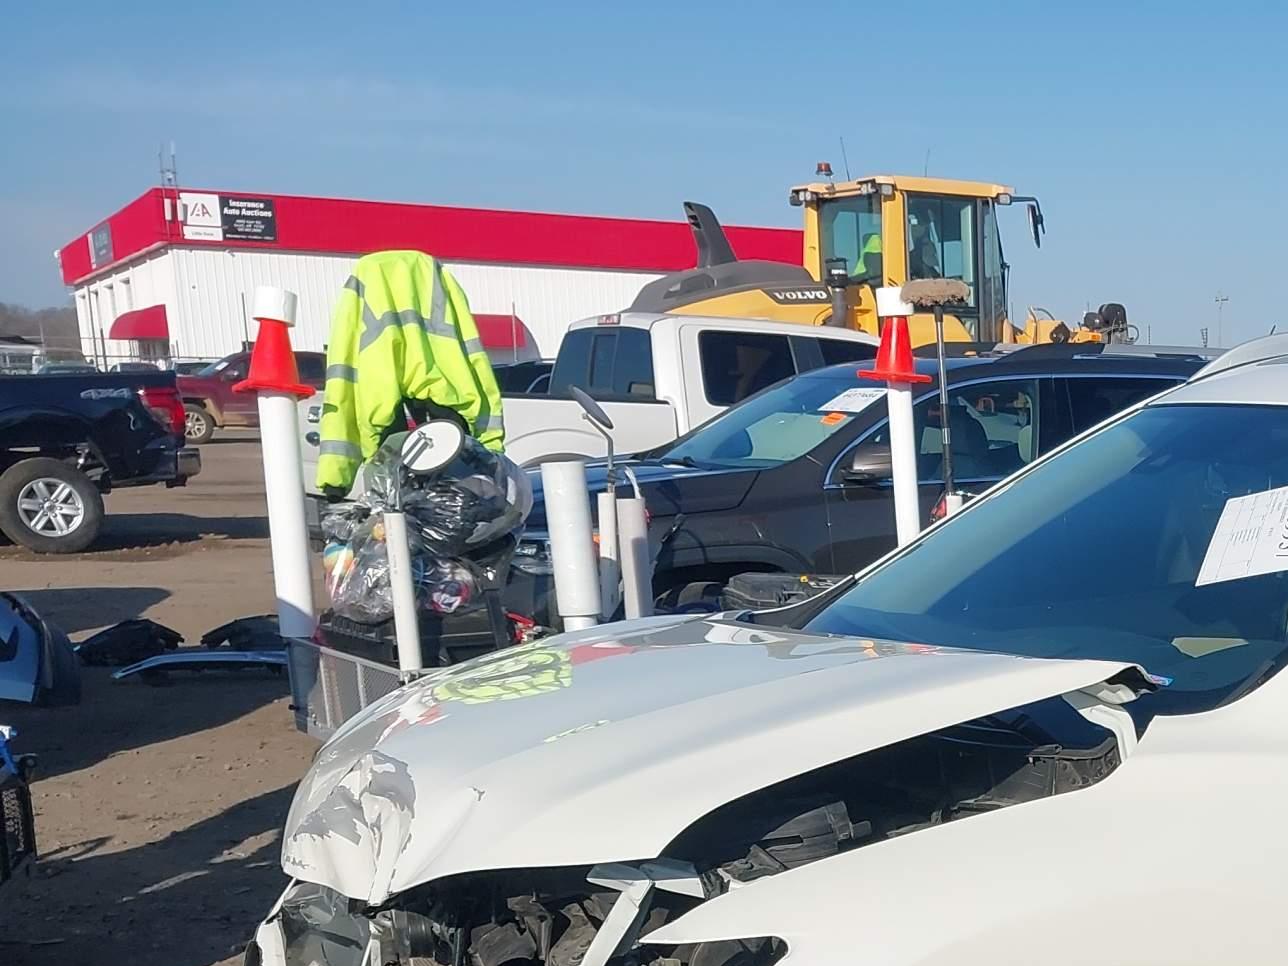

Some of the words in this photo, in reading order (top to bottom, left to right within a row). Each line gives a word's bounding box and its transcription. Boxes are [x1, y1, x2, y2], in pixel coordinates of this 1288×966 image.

[228, 199, 265, 209] Insurance
[223, 207, 240, 215] Auto
[241, 208, 272, 217] Auctions
[773, 290, 828, 300] VOLVO
